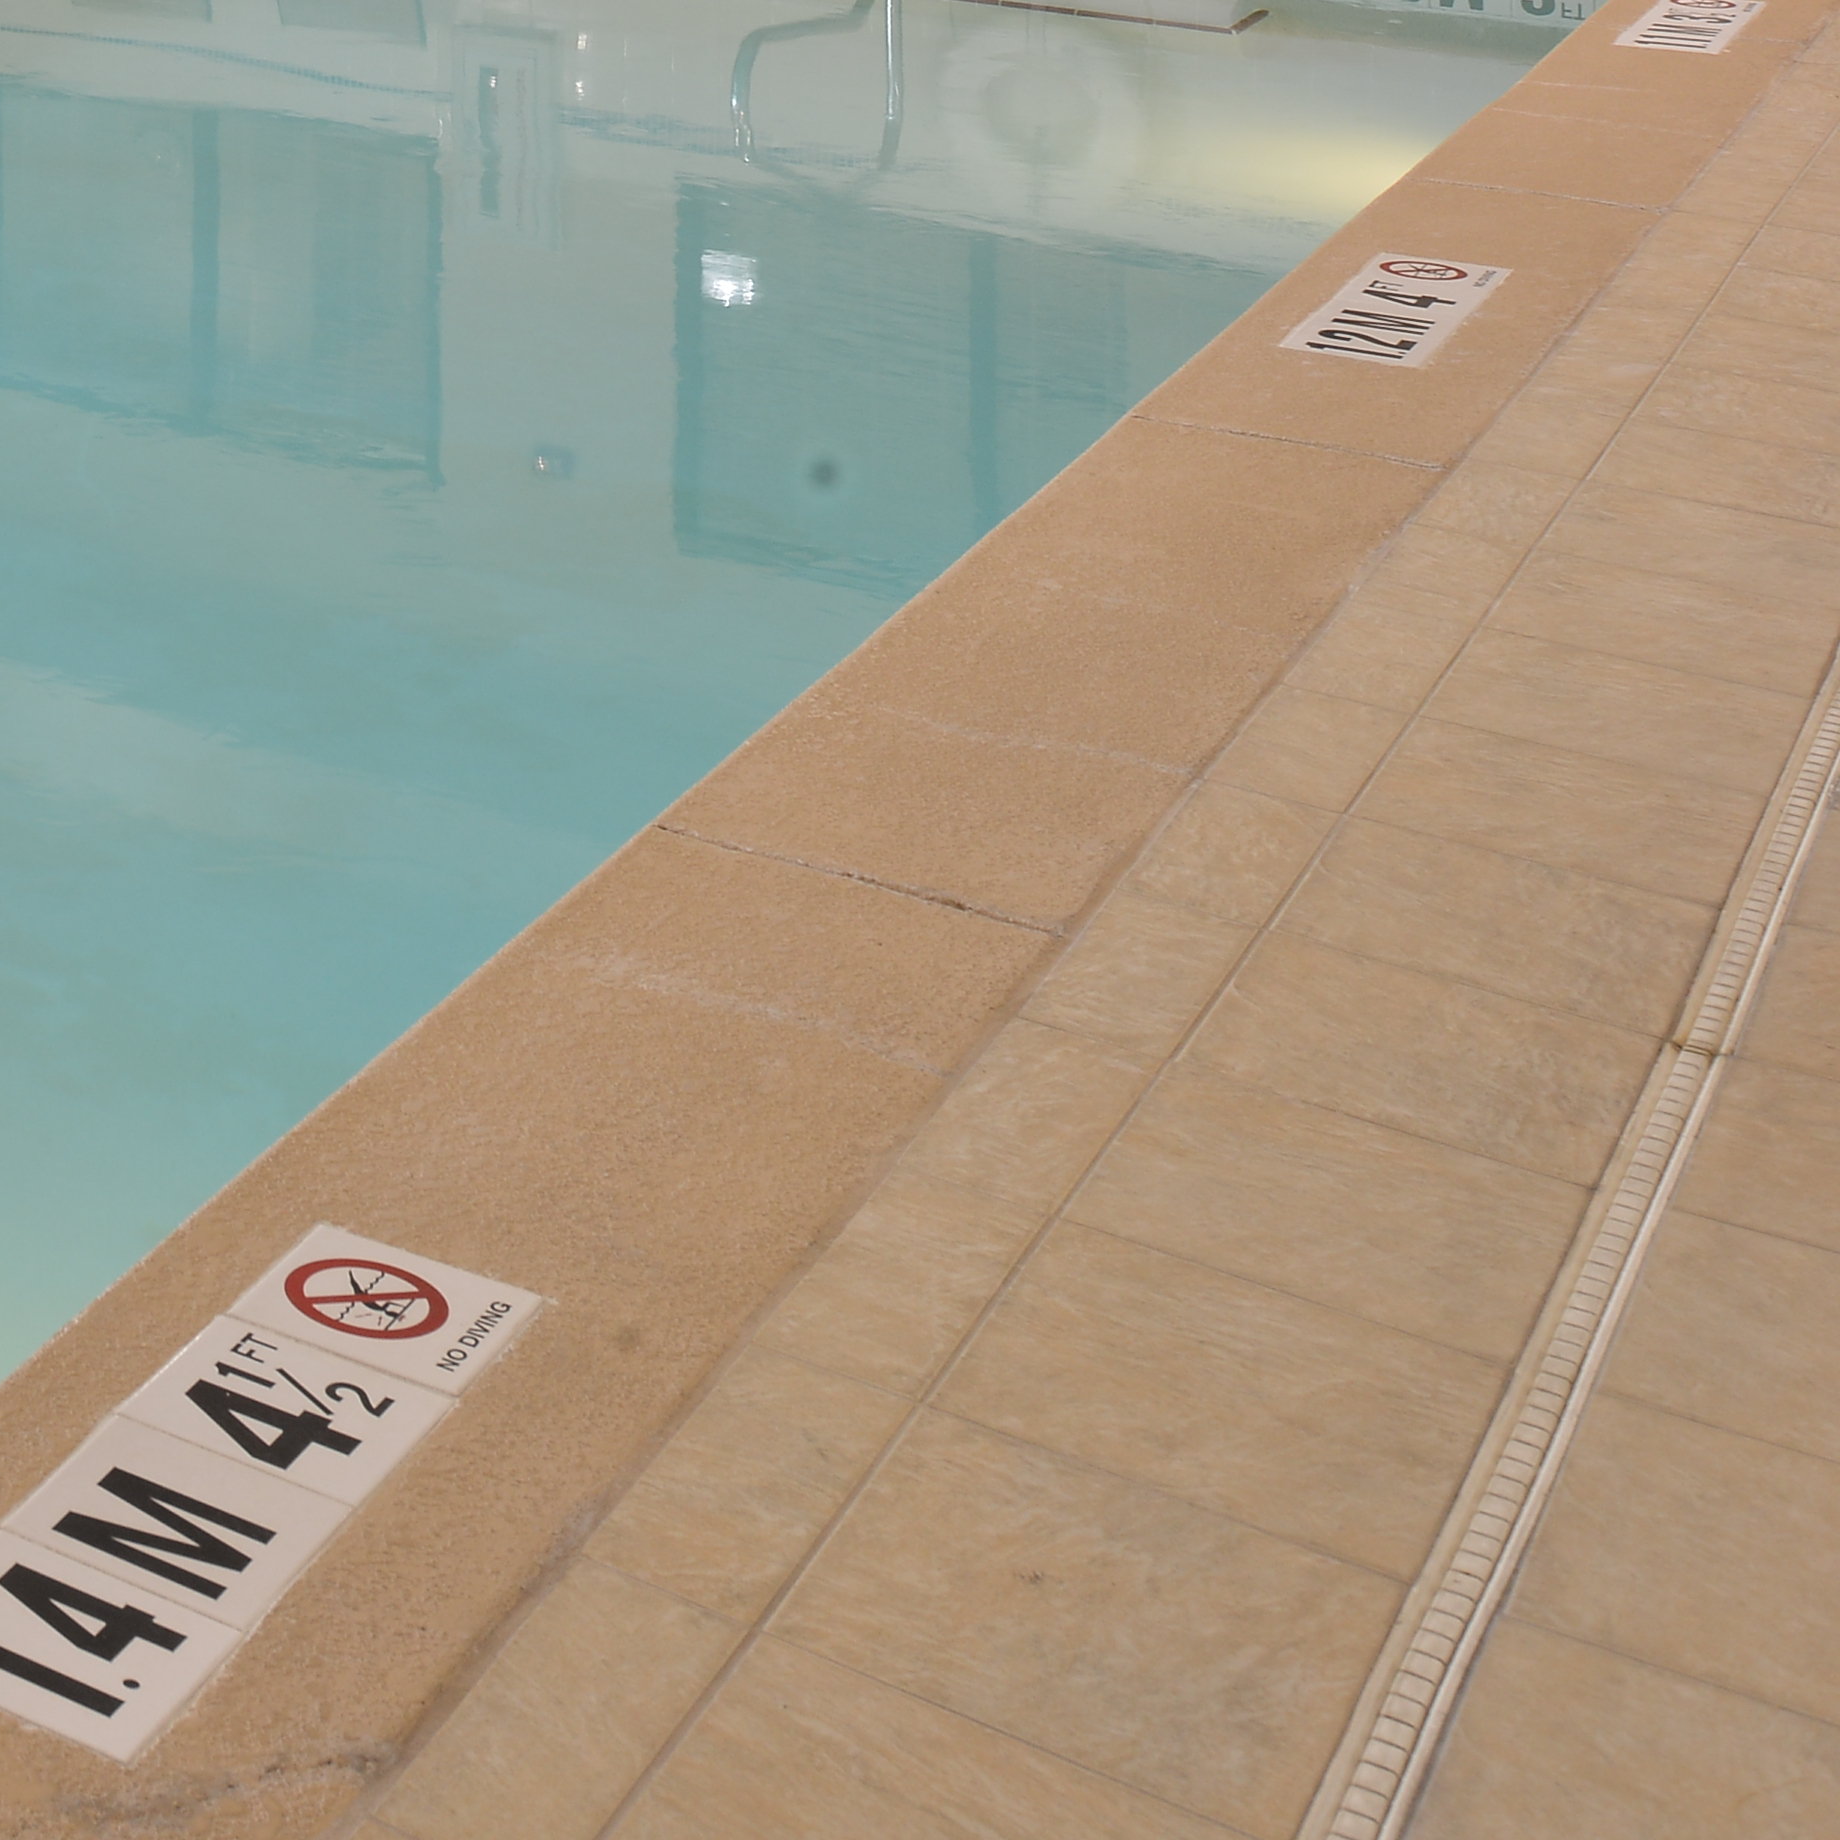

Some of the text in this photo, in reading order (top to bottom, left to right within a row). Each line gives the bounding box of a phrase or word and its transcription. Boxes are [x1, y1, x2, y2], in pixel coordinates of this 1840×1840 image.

[1362, 288, 1456, 309] 4
[230, 1332, 279, 1365] FT
[436, 1301, 512, 1373] NO DIVING
